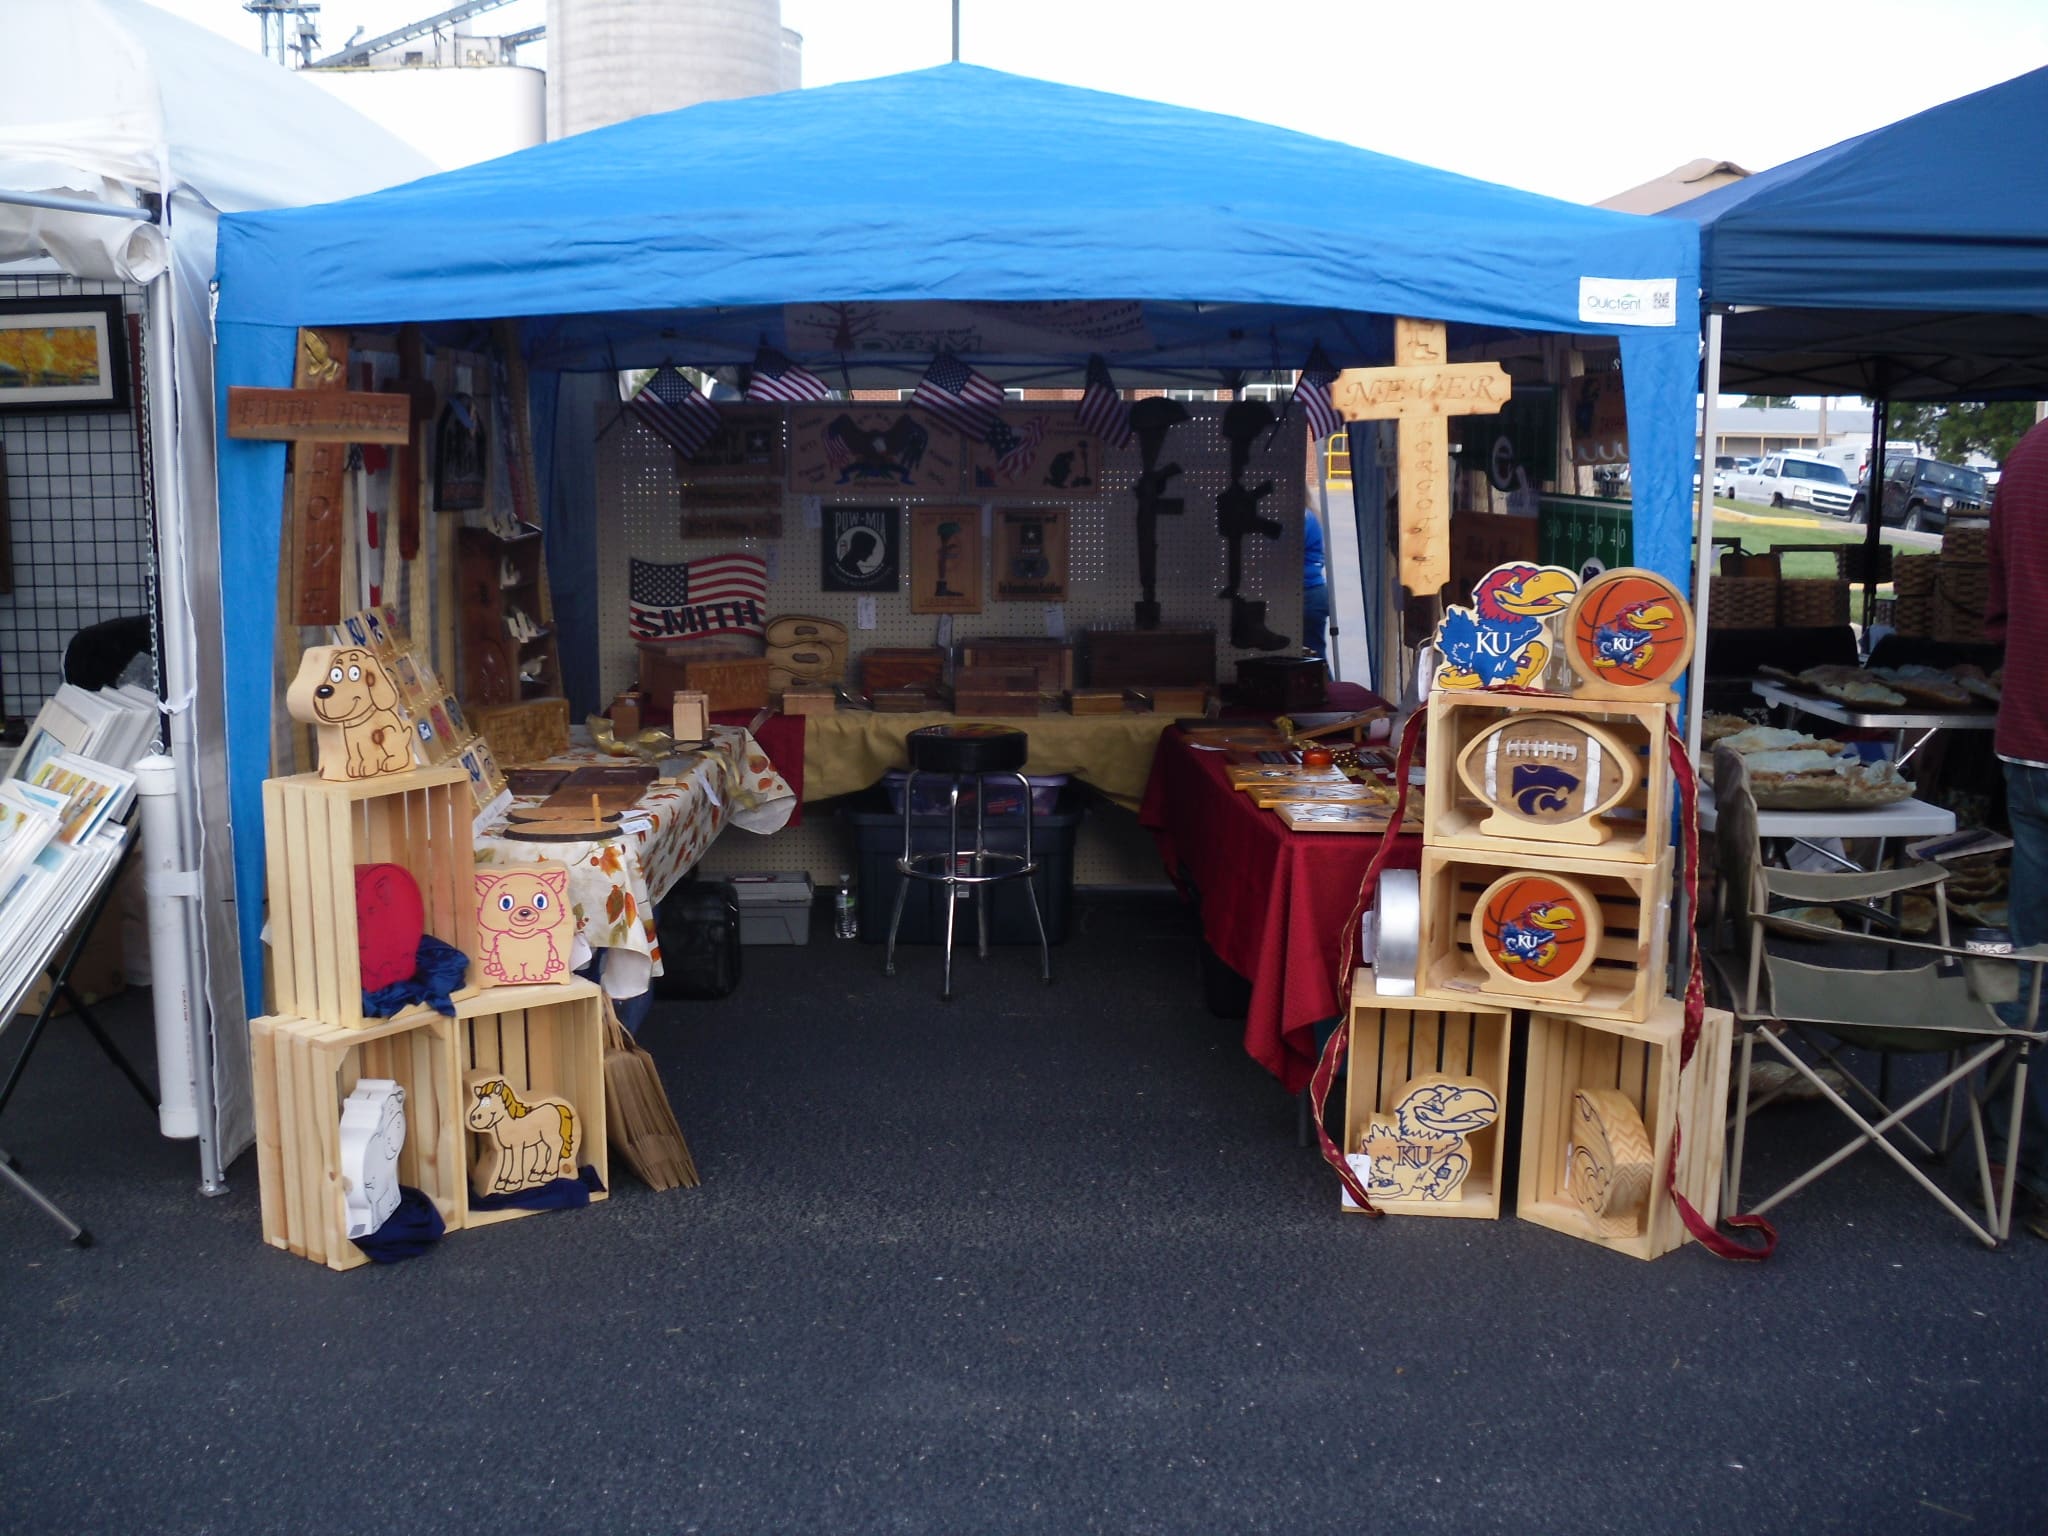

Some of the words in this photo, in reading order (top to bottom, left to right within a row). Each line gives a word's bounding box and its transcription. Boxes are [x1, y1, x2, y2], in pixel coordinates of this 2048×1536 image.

[1344, 374, 1503, 407] NEVER
[1587, 523, 1604, 545] 50
[1610, 527, 1626, 548] 40
[636, 599, 760, 637] SMITH
[1476, 631, 1512, 656] KU
[1612, 637, 1635, 651] KU
[1518, 934, 1538, 949] KU
[1396, 1145, 1434, 1169] KU
